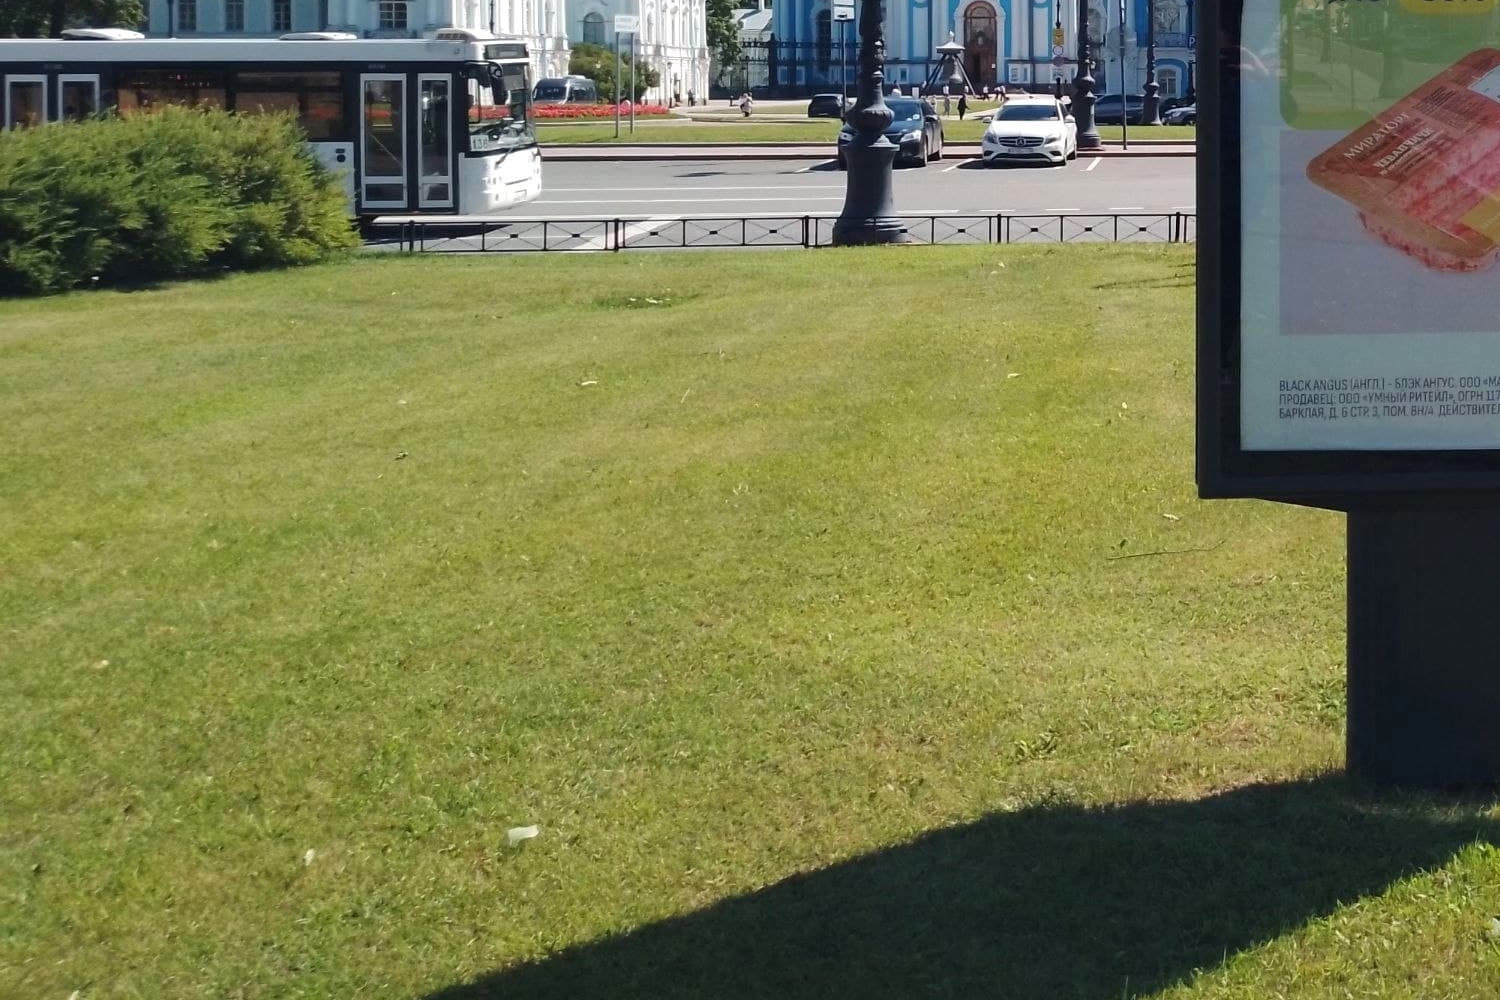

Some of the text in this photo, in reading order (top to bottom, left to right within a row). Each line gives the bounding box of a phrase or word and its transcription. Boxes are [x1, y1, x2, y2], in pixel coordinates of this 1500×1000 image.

[1343, 112, 1410, 160] МИРАТОРГ
[1279, 380, 1310, 391] BLACK
[1313, 379, 1348, 391] ANGUS
[1394, 378, 1421, 389] БЛЭК
[1459, 376, 1481, 388] ООО
[1338, 392, 1360, 404] ООО
[1362, 391, 1407, 404] «УМНЫЙ
[1458, 390, 1483, 402] ОГРН
